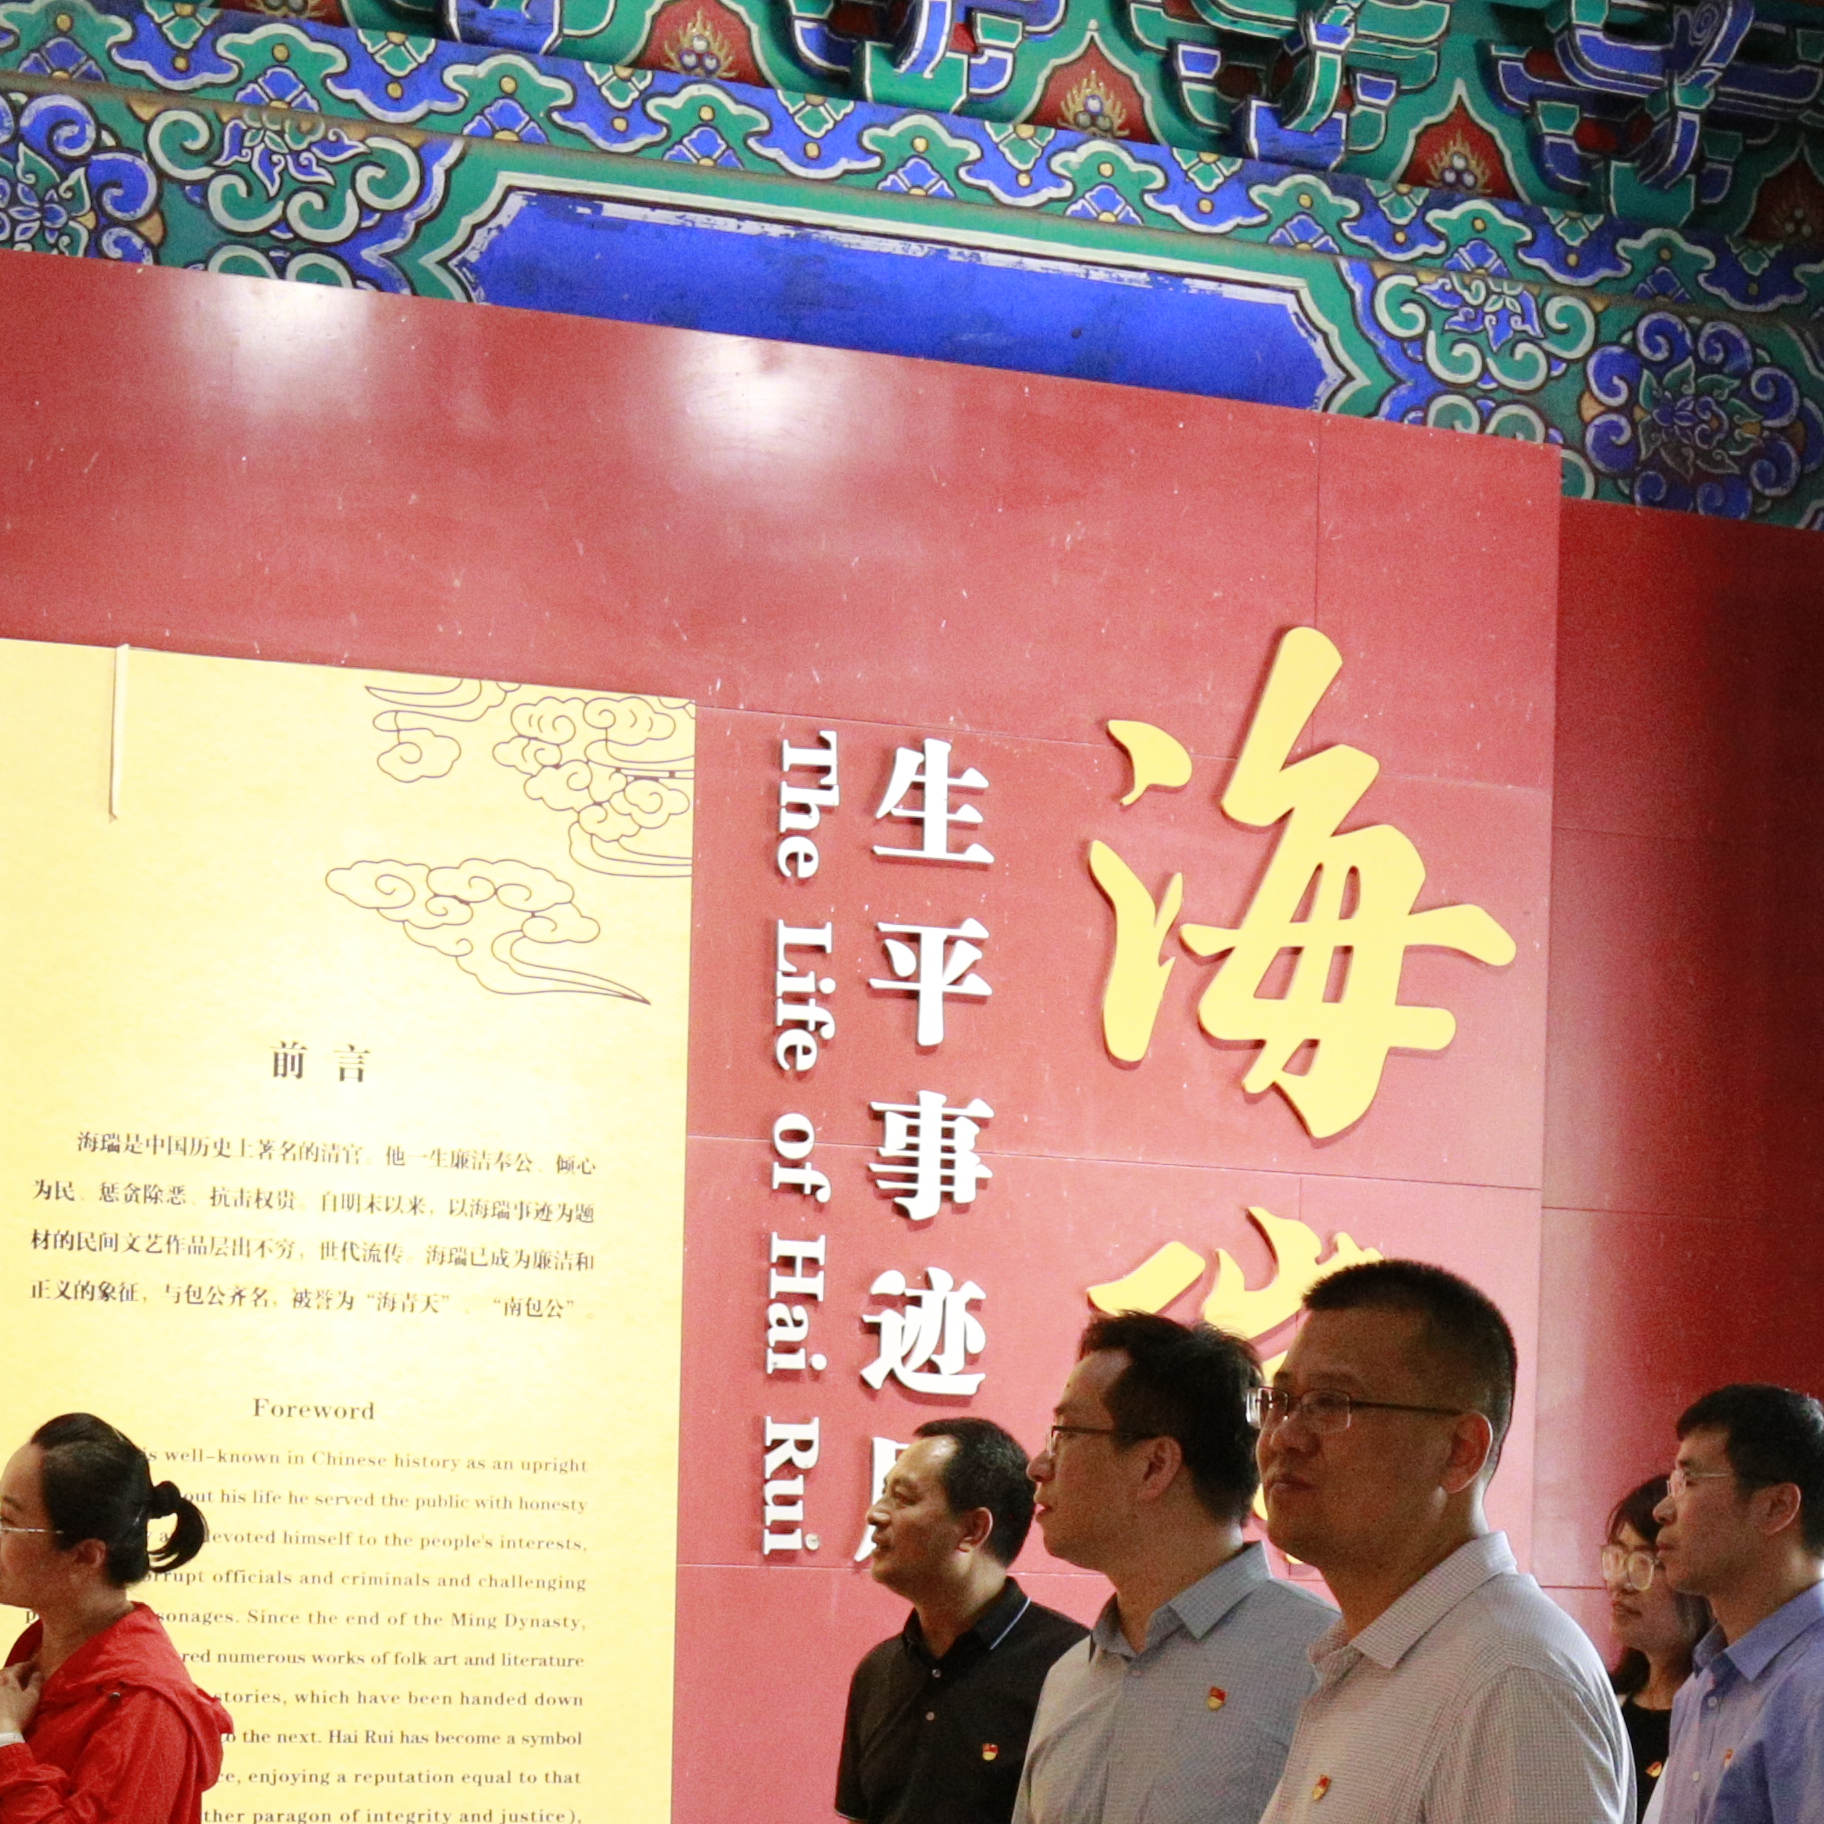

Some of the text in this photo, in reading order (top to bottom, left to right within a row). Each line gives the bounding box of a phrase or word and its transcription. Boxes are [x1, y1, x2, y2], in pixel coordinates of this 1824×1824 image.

[270, 1039, 372, 1084] 前言
[761, 729, 840, 1557] The Life of Hai Rui
[252, 1397, 375, 1421] Foreword
[287, 1449, 305, 1465] in
[311, 1450, 387, 1467] Chinese
[394, 1452, 460, 1473] history
[465, 1458, 486, 1470] as
[492, 1460, 514, 1471] an
[520, 1457, 587, 1475] upright
[220, 1488, 247, 1504] his
[252, 1489, 282, 1505] life
[288, 1490, 309, 1505] he
[314, 1492, 375, 1507] served
[381, 1492, 409, 1507] the
[415, 1493, 469, 1512] public
[474, 1495, 513, 1510] with
[519, 1495, 585, 1515] honesty
[207, 1526, 276, 1545] evoted
[283, 1529, 353, 1546] himself
[358, 1533, 377, 1546] to
[384, 1532, 414, 1547] the
[144, 1568, 587, 1592] orrupt officials and criminals and challenging
[158, 1610, 240, 1626] sonages.
[247, 1609, 300, 1625] Since
[307, 1610, 339, 1625] the
[345, 1610, 380, 1626] end
[387, 1611, 408, 1626] of
[413, 1611, 443, 1627] the
[451, 1611, 497, 1630] Ming
[216, 1652, 306, 1665] numerous
[311, 1650, 366, 1665] works
[370, 1650, 389, 1666] of
[393, 1650, 428, 1666] folk
[432, 1653, 458, 1666] art
[463, 1651, 496, 1667] and
[501, 1652, 586, 1668] literature
[293, 1689, 350, 1705] which
[357, 1690, 401, 1705] have
[408, 1690, 453, 1706] been
[459, 1690, 528, 1706] handed
[533, 1691, 584, 1707] down
[242, 1728, 272, 1744] the
[328, 1728, 359, 1745] Hai
[364, 1729, 394, 1745] Rui
[399, 1729, 430, 1745] has
[434, 1730, 502, 1745] become
[506, 1734, 516, 1745] a
[521, 1730, 582, 1749] symbol
[247, 1768, 331, 1787] enjoying
[336, 1773, 347, 1784] a
[354, 1769, 455, 1787] reputation
[460, 1769, 512, 1788] equal
[519, 1771, 538, 1784] to
[544, 1769, 581, 1785] that
[339, 1808, 361, 1823] of
[458, 1808, 493, 1824] and
